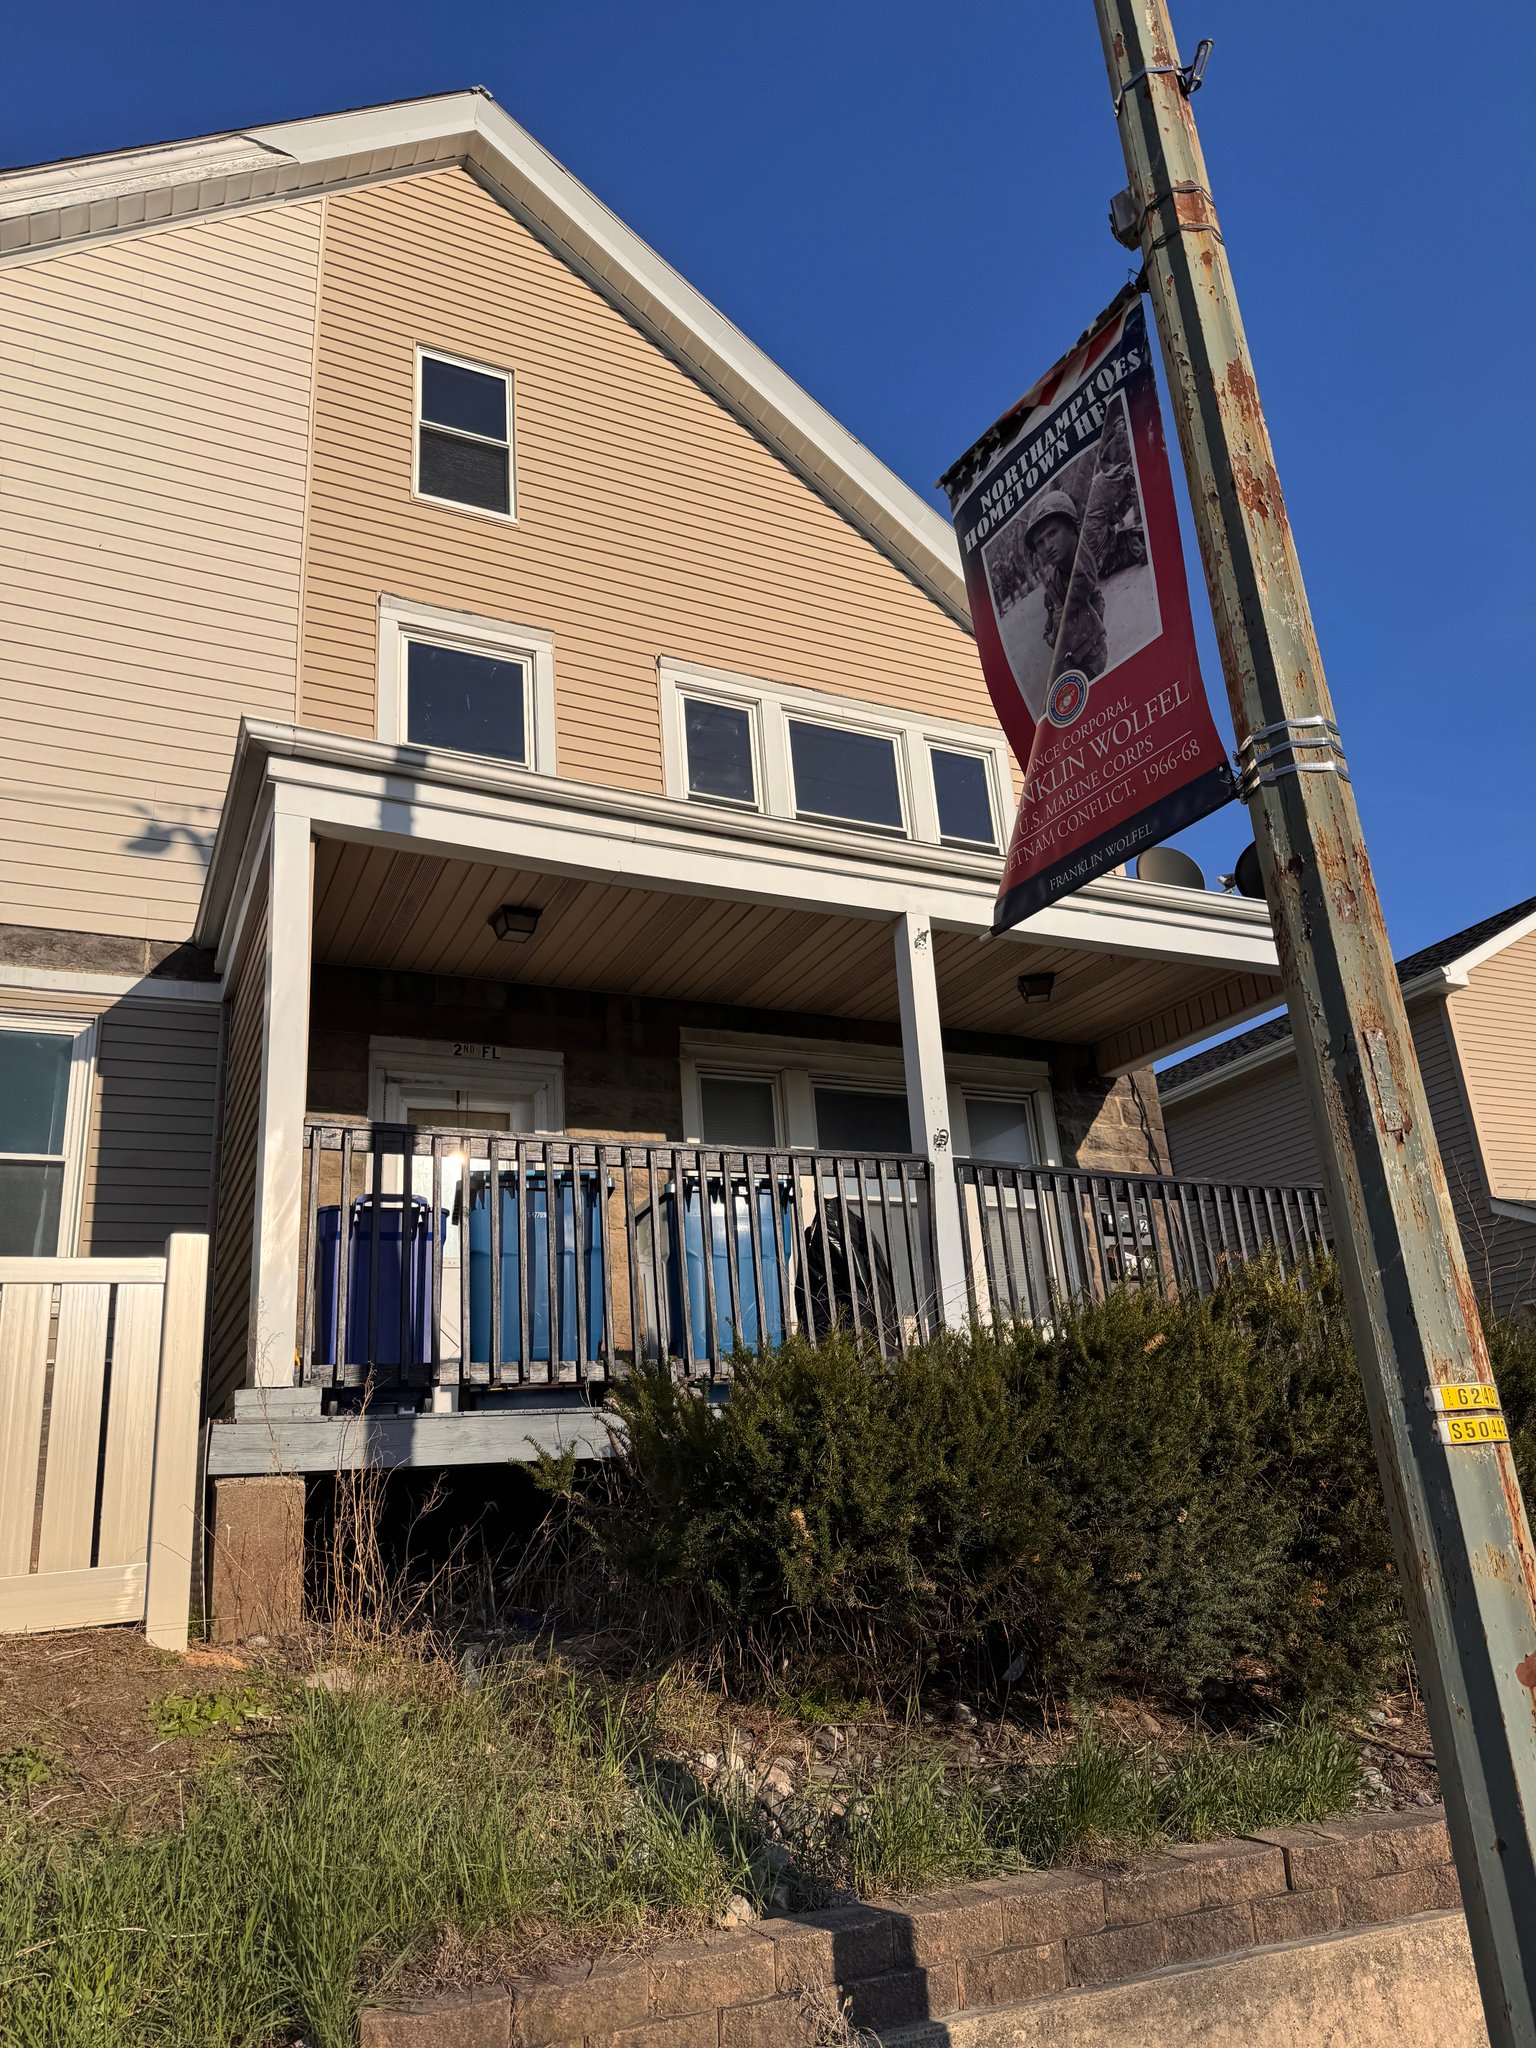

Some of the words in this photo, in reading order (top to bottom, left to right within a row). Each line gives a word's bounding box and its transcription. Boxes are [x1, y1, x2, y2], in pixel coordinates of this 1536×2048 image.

[963, 435, 1069, 554] HOMETOWN
[1072, 394, 1113, 442] HE
[1018, 746, 1086, 815] NKLIN
[1088, 681, 1190, 760] WOLFEL
[1019, 804, 1045, 835] U.S.
[1046, 773, 1101, 819] MARINE
[1103, 734, 1155, 779] CORPS
[1026, 741, 1060, 777] ANCE
[1062, 695, 1132, 752] CORPORAL
[1057, 777, 1137, 839] CONFLICT,
[1142, 738, 1202, 787] 1966-68
[1050, 850, 1103, 891] FRANKLIN
[1105, 823, 1153, 859] WOLFEL
[482, 1045, 501, 1060] FL
